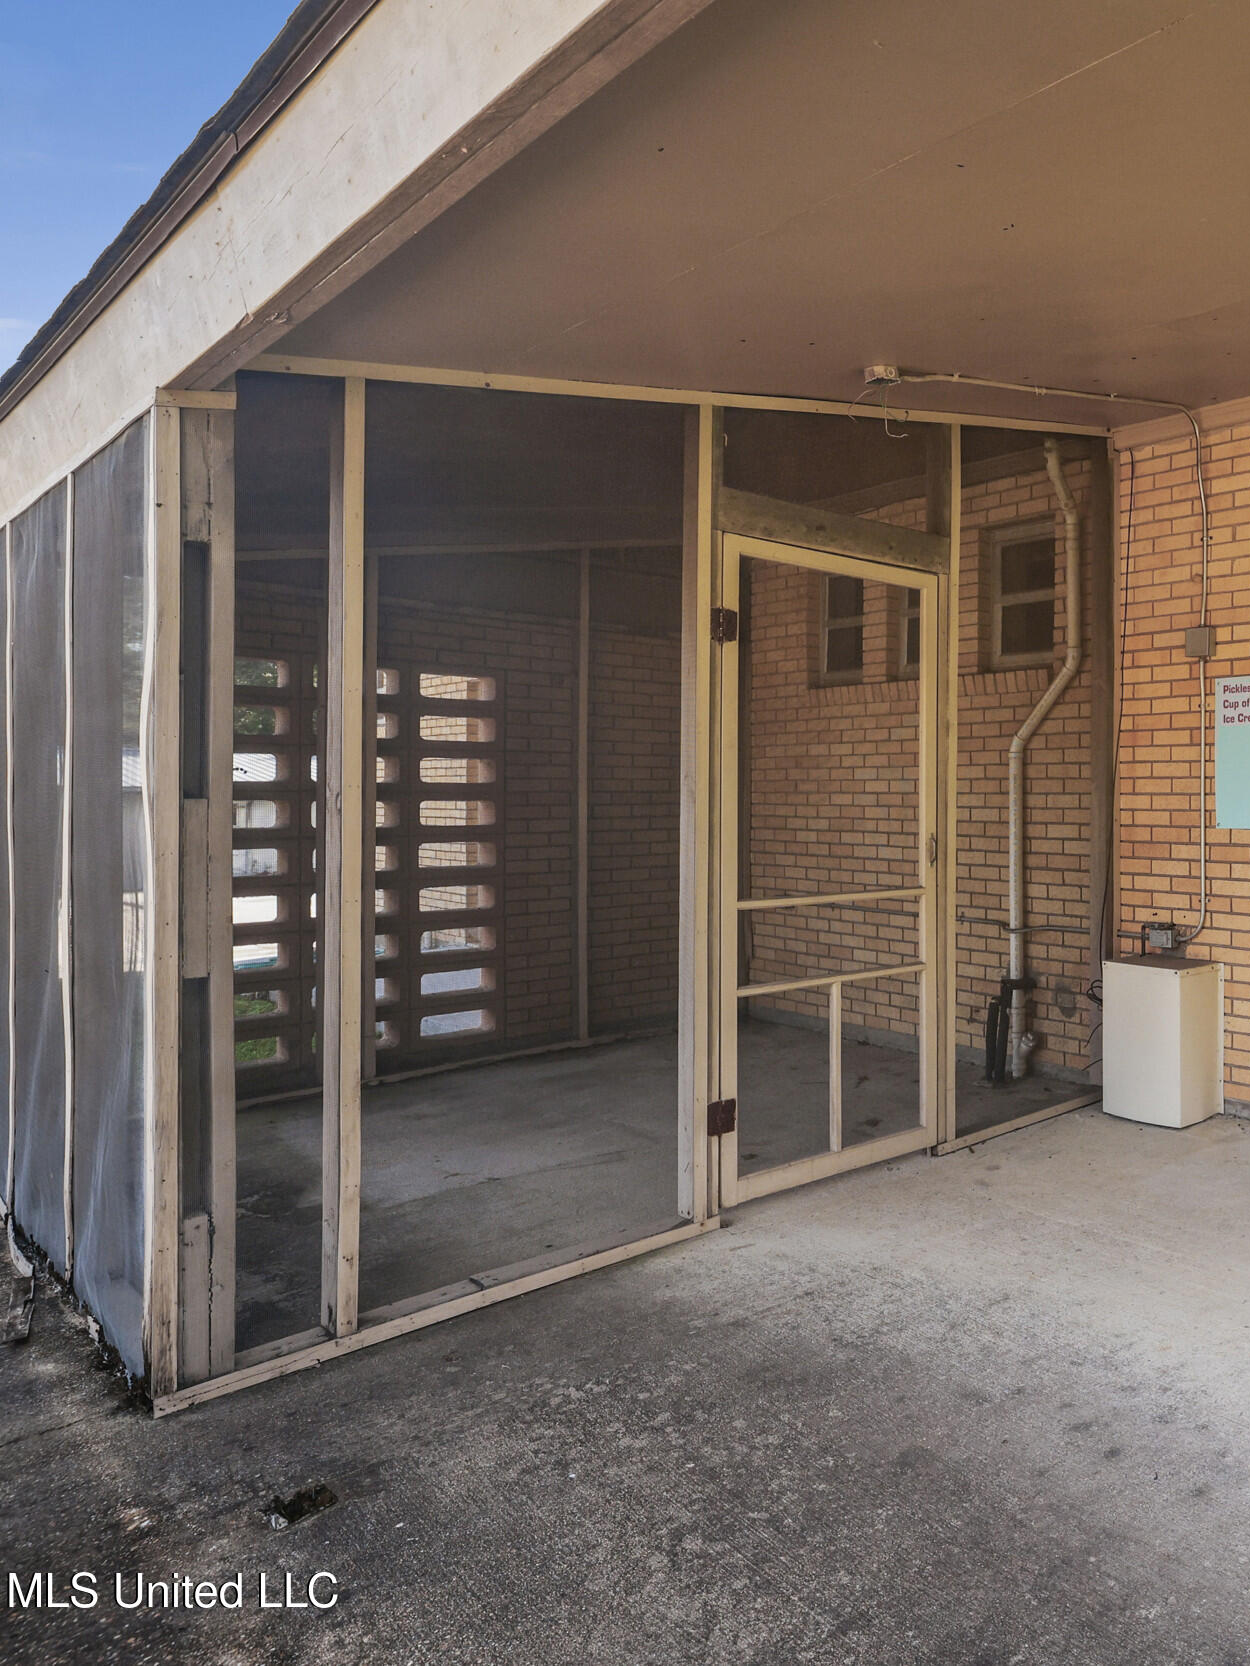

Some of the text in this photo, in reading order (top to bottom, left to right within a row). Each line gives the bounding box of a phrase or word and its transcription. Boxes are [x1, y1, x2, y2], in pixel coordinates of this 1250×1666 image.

[1223, 699, 1239, 711] Cup
[1242, 699, 1249, 707] of
[1223, 714, 1235, 723] Ice
